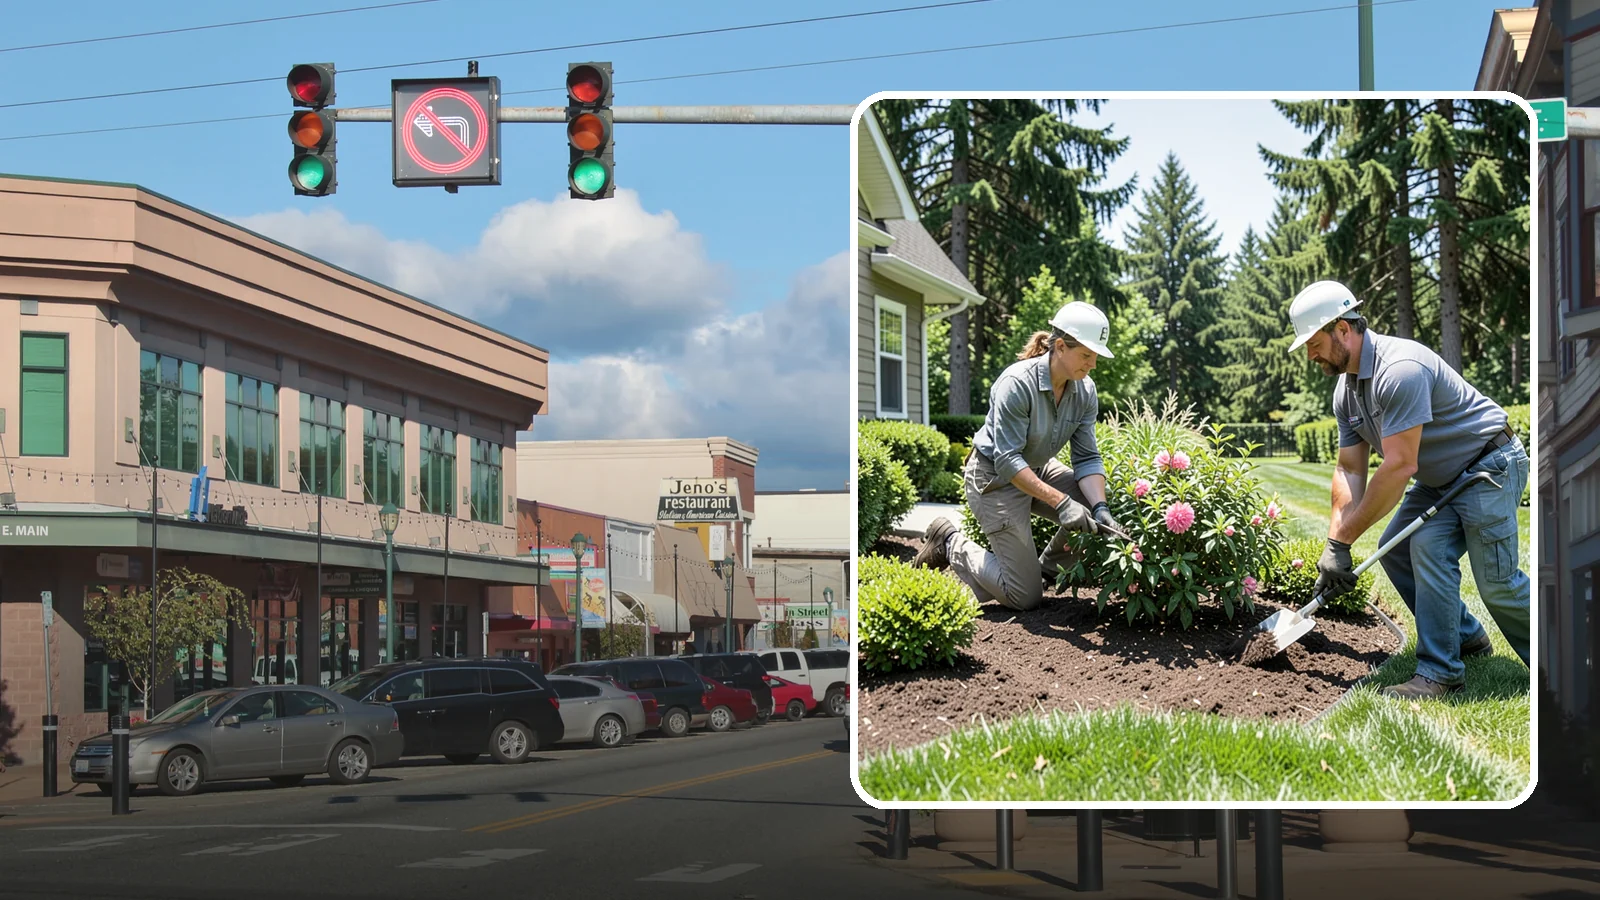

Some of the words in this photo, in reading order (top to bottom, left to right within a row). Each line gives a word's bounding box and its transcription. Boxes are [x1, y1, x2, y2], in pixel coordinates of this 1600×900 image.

[670, 480, 727, 494] Jeno's
[665, 496, 731, 509] restaurant
[658, 510, 681, 519] Italian
[686, 510, 714, 519] American
[715, 510, 738, 519] Cuisine
[2, 525, 13, 536] E.
[15, 525, 49, 536] MAIN
[797, 607, 828, 616] Street
[791, 619, 823, 627] lass
